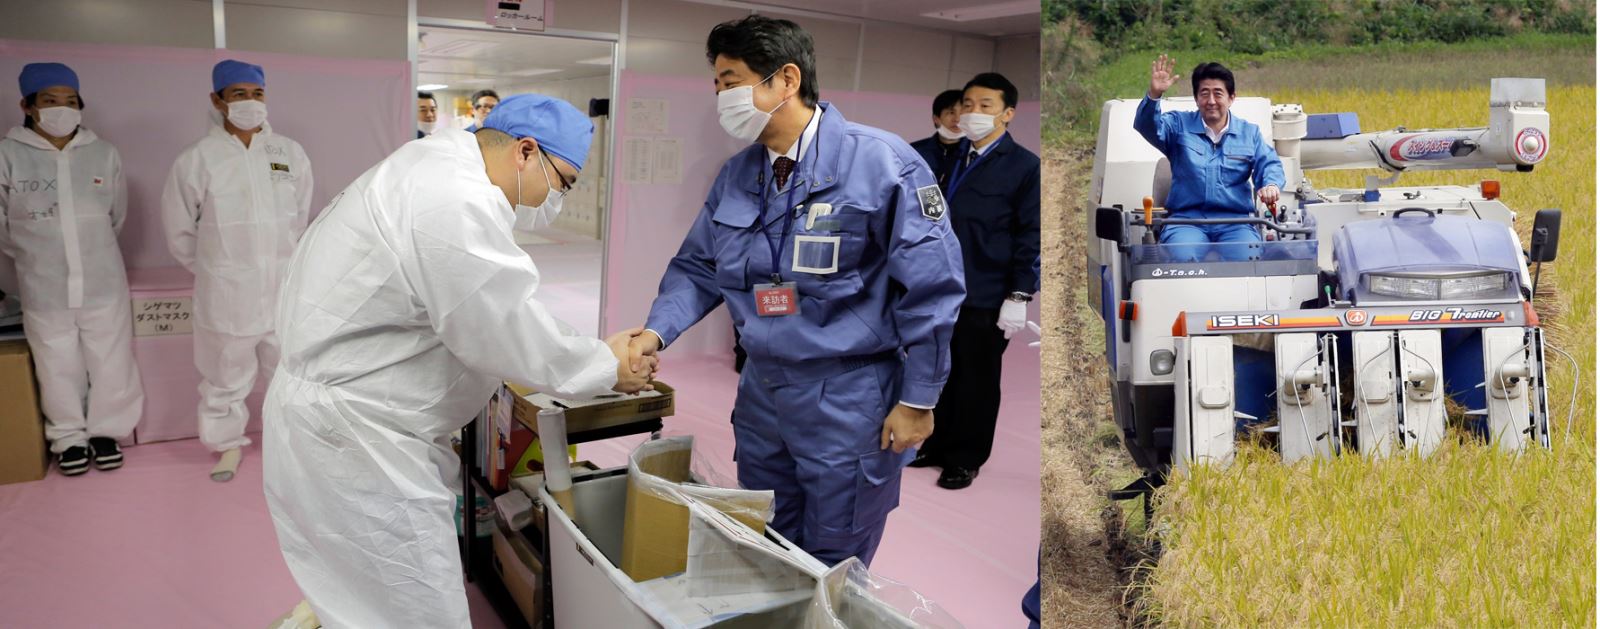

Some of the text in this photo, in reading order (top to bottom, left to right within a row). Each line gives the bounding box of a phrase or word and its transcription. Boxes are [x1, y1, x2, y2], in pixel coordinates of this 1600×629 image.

[143, 301, 182, 311] シゲマツ
[136, 312, 190, 322] ダストマスク
[1408, 310, 1442, 321] BIG
[1211, 314, 1280, 328] ISEKI
